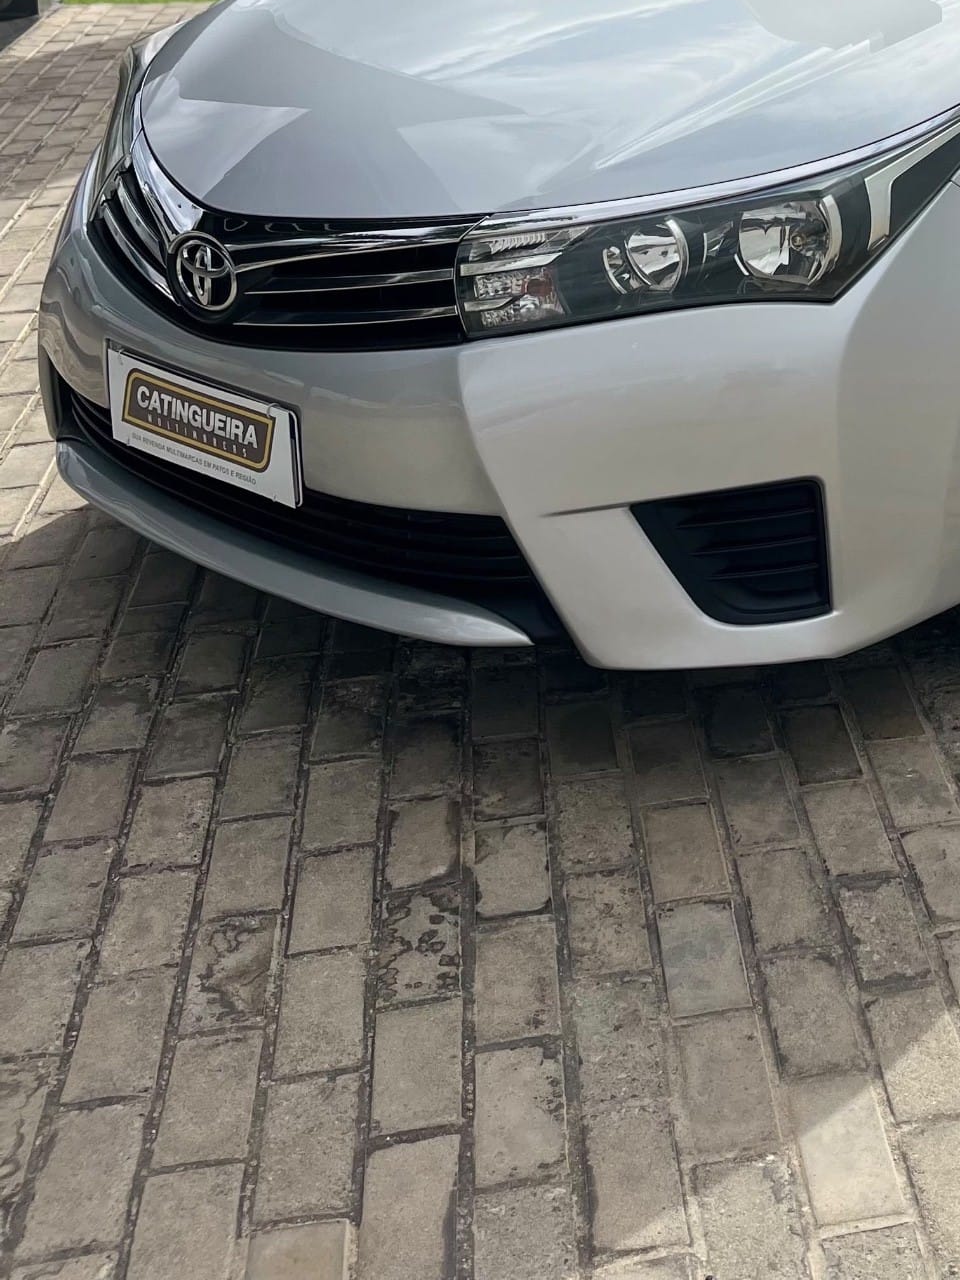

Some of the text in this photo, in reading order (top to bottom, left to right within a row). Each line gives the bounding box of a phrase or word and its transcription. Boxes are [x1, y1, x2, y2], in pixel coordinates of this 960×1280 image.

[137, 385, 258, 449] CATINGUEIRA
[147, 413, 247, 458] MULTIMARCAS
[142, 435, 166, 451] REVENDA
[166, 445, 203, 467] MULTIMARCAS
[203, 459, 213, 469] EM
[212, 463, 230, 477] PATOS
[235, 470, 257, 486] REGIÃO
